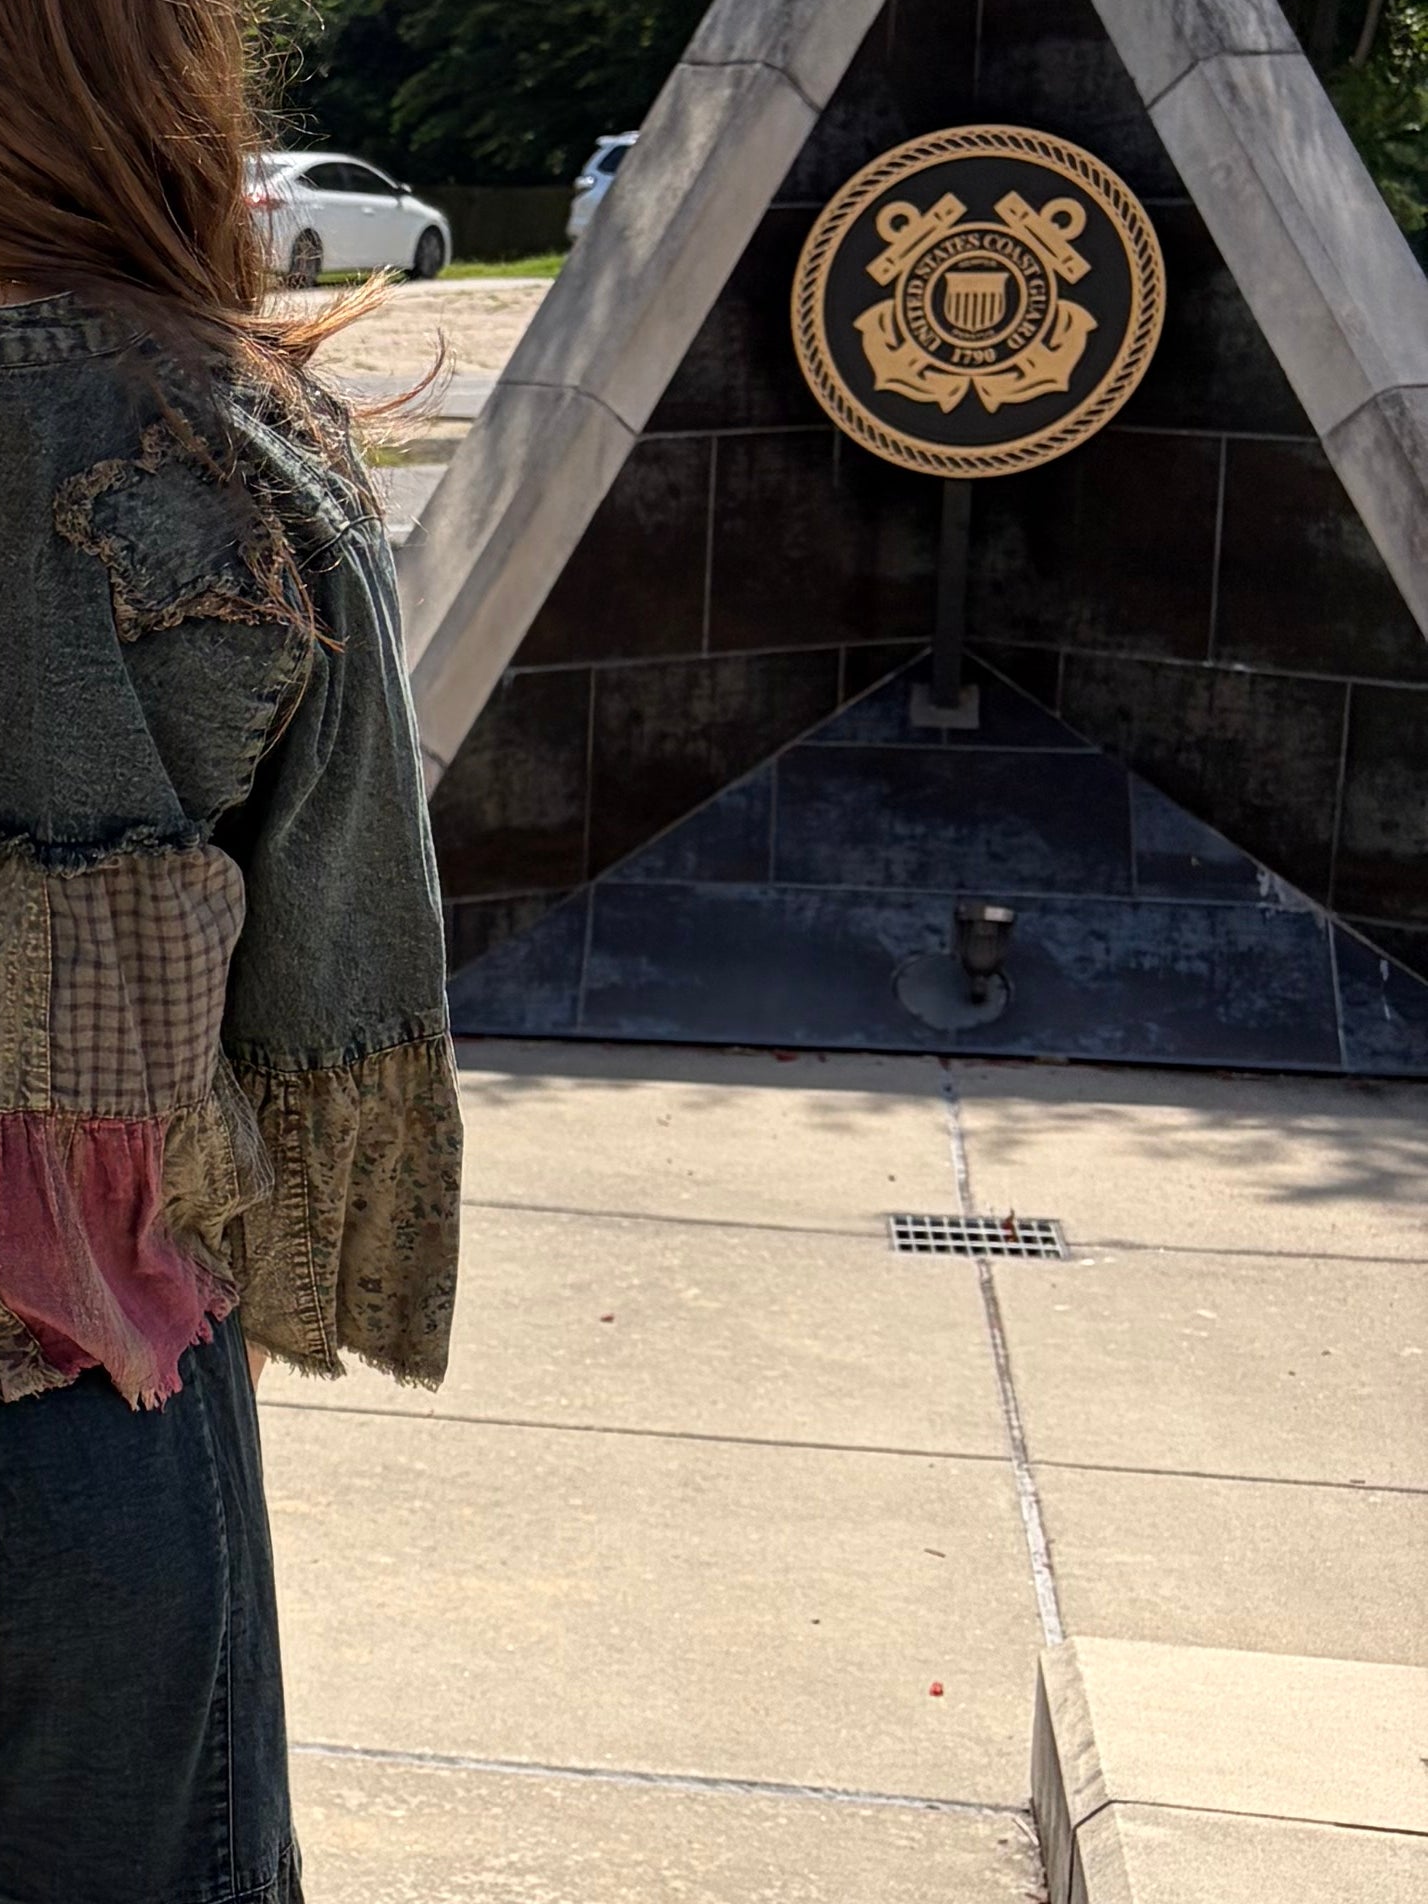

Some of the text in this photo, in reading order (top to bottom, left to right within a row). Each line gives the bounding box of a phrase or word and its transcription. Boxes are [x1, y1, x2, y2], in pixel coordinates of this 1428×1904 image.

[907, 233, 1046, 351] UNITED STATES COAST GUARD
[951, 348, 996, 364] 1790
